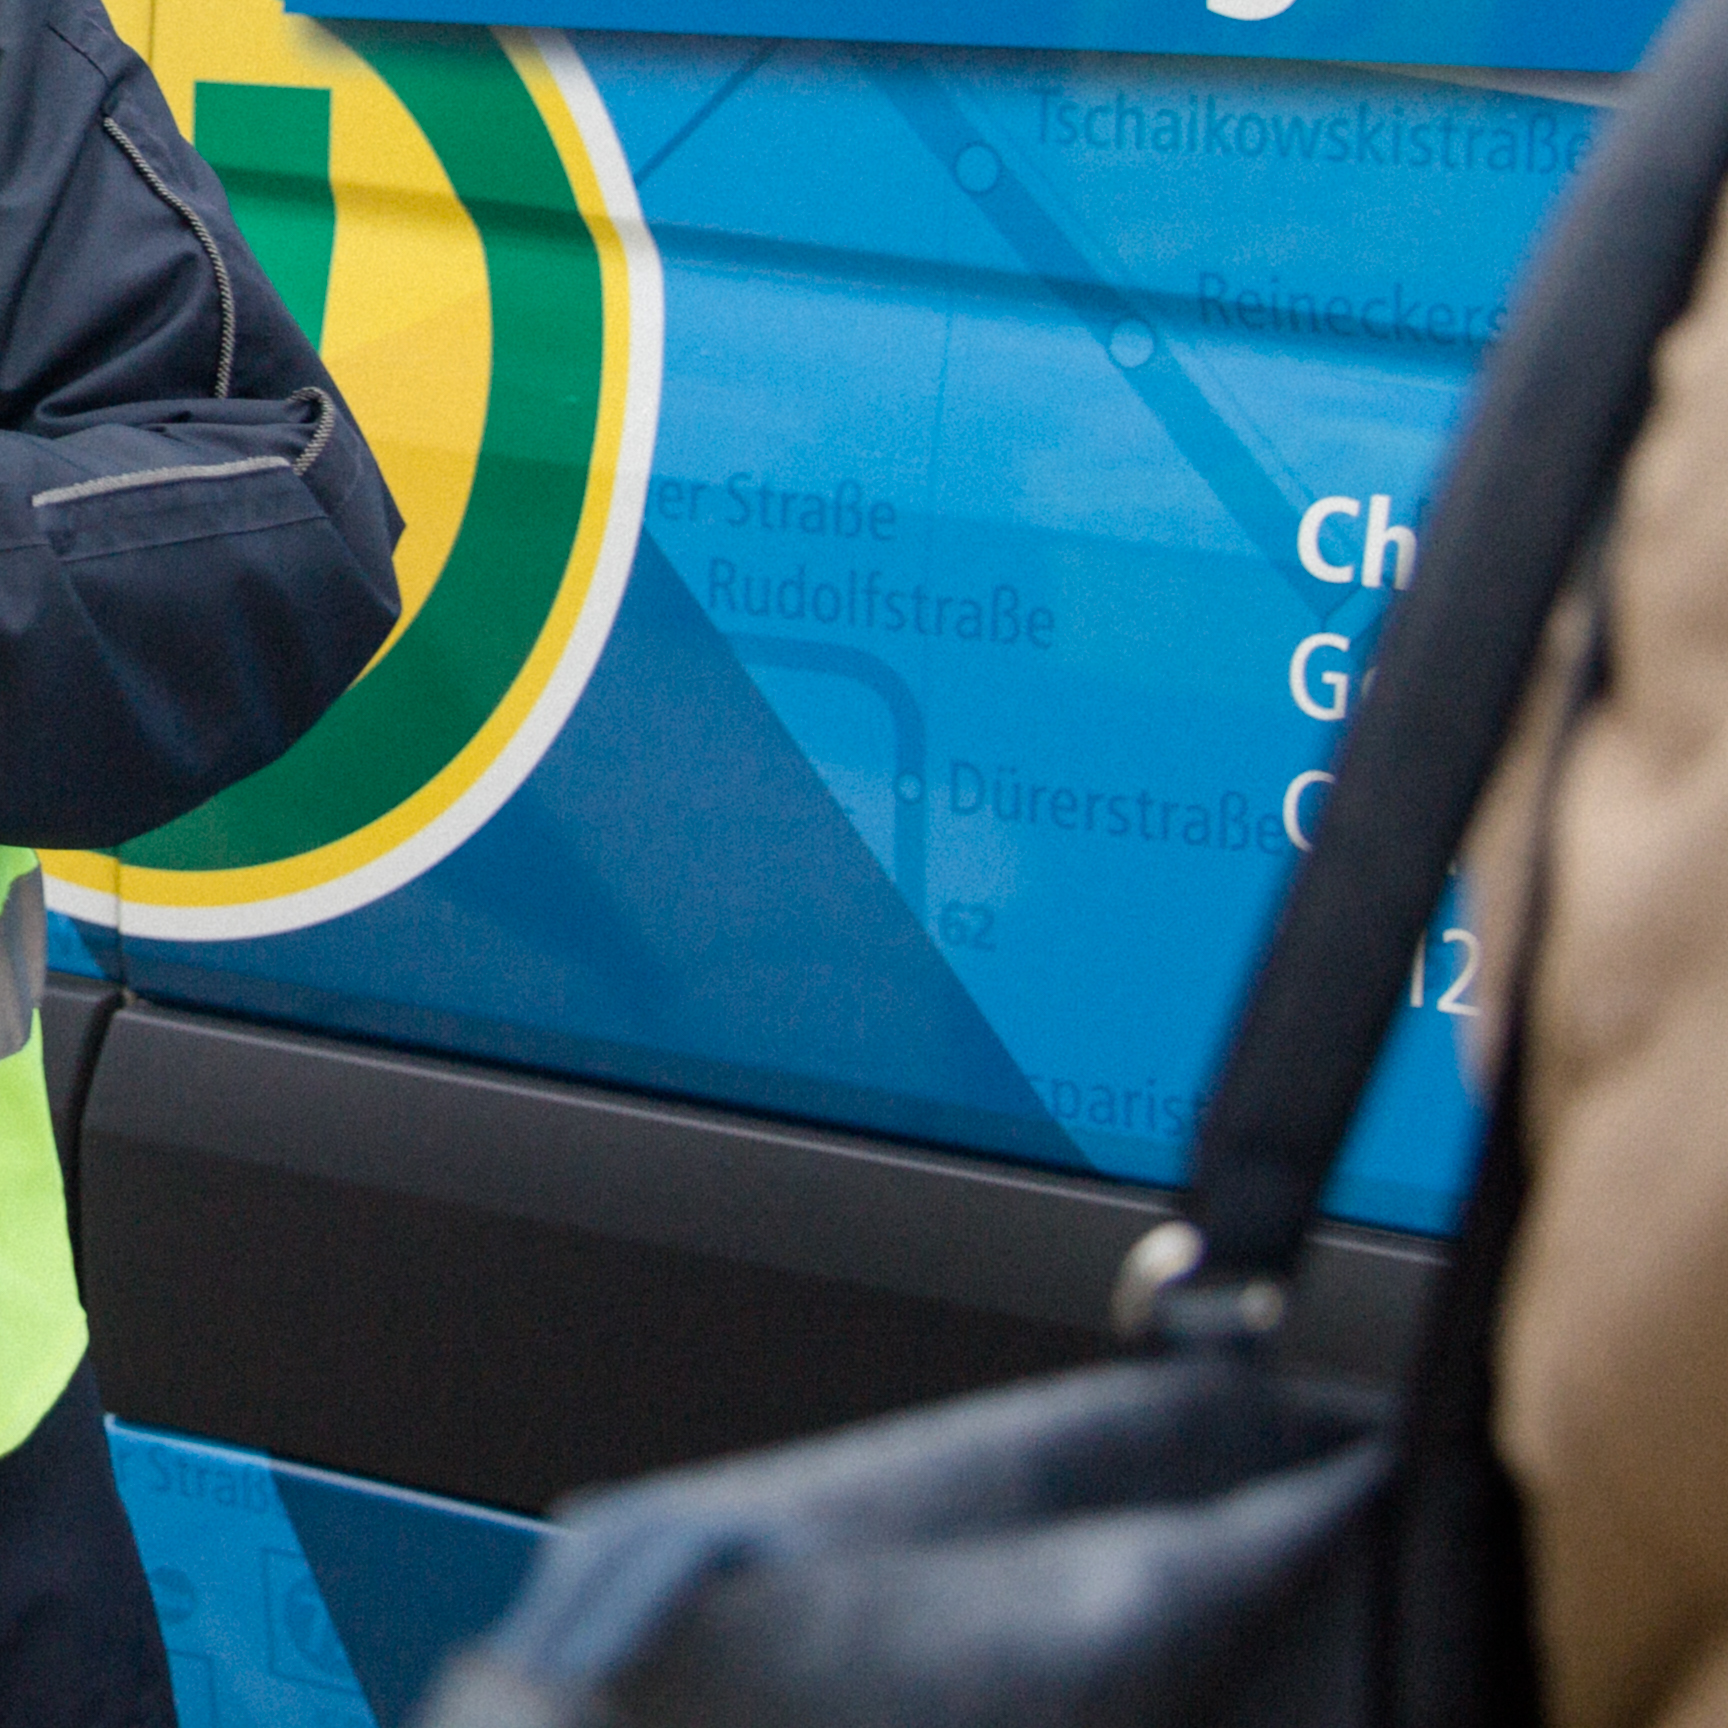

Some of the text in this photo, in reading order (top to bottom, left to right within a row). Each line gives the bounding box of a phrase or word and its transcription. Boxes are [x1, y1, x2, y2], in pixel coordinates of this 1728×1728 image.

[1035, 84, 1598, 174] Tschaikowskistraße
[725, 472, 897, 542] Straße
[707, 556, 1056, 651] Rudolfstraße
[949, 759, 1287, 856] Dürerstraße
[941, 900, 997, 952] 62
